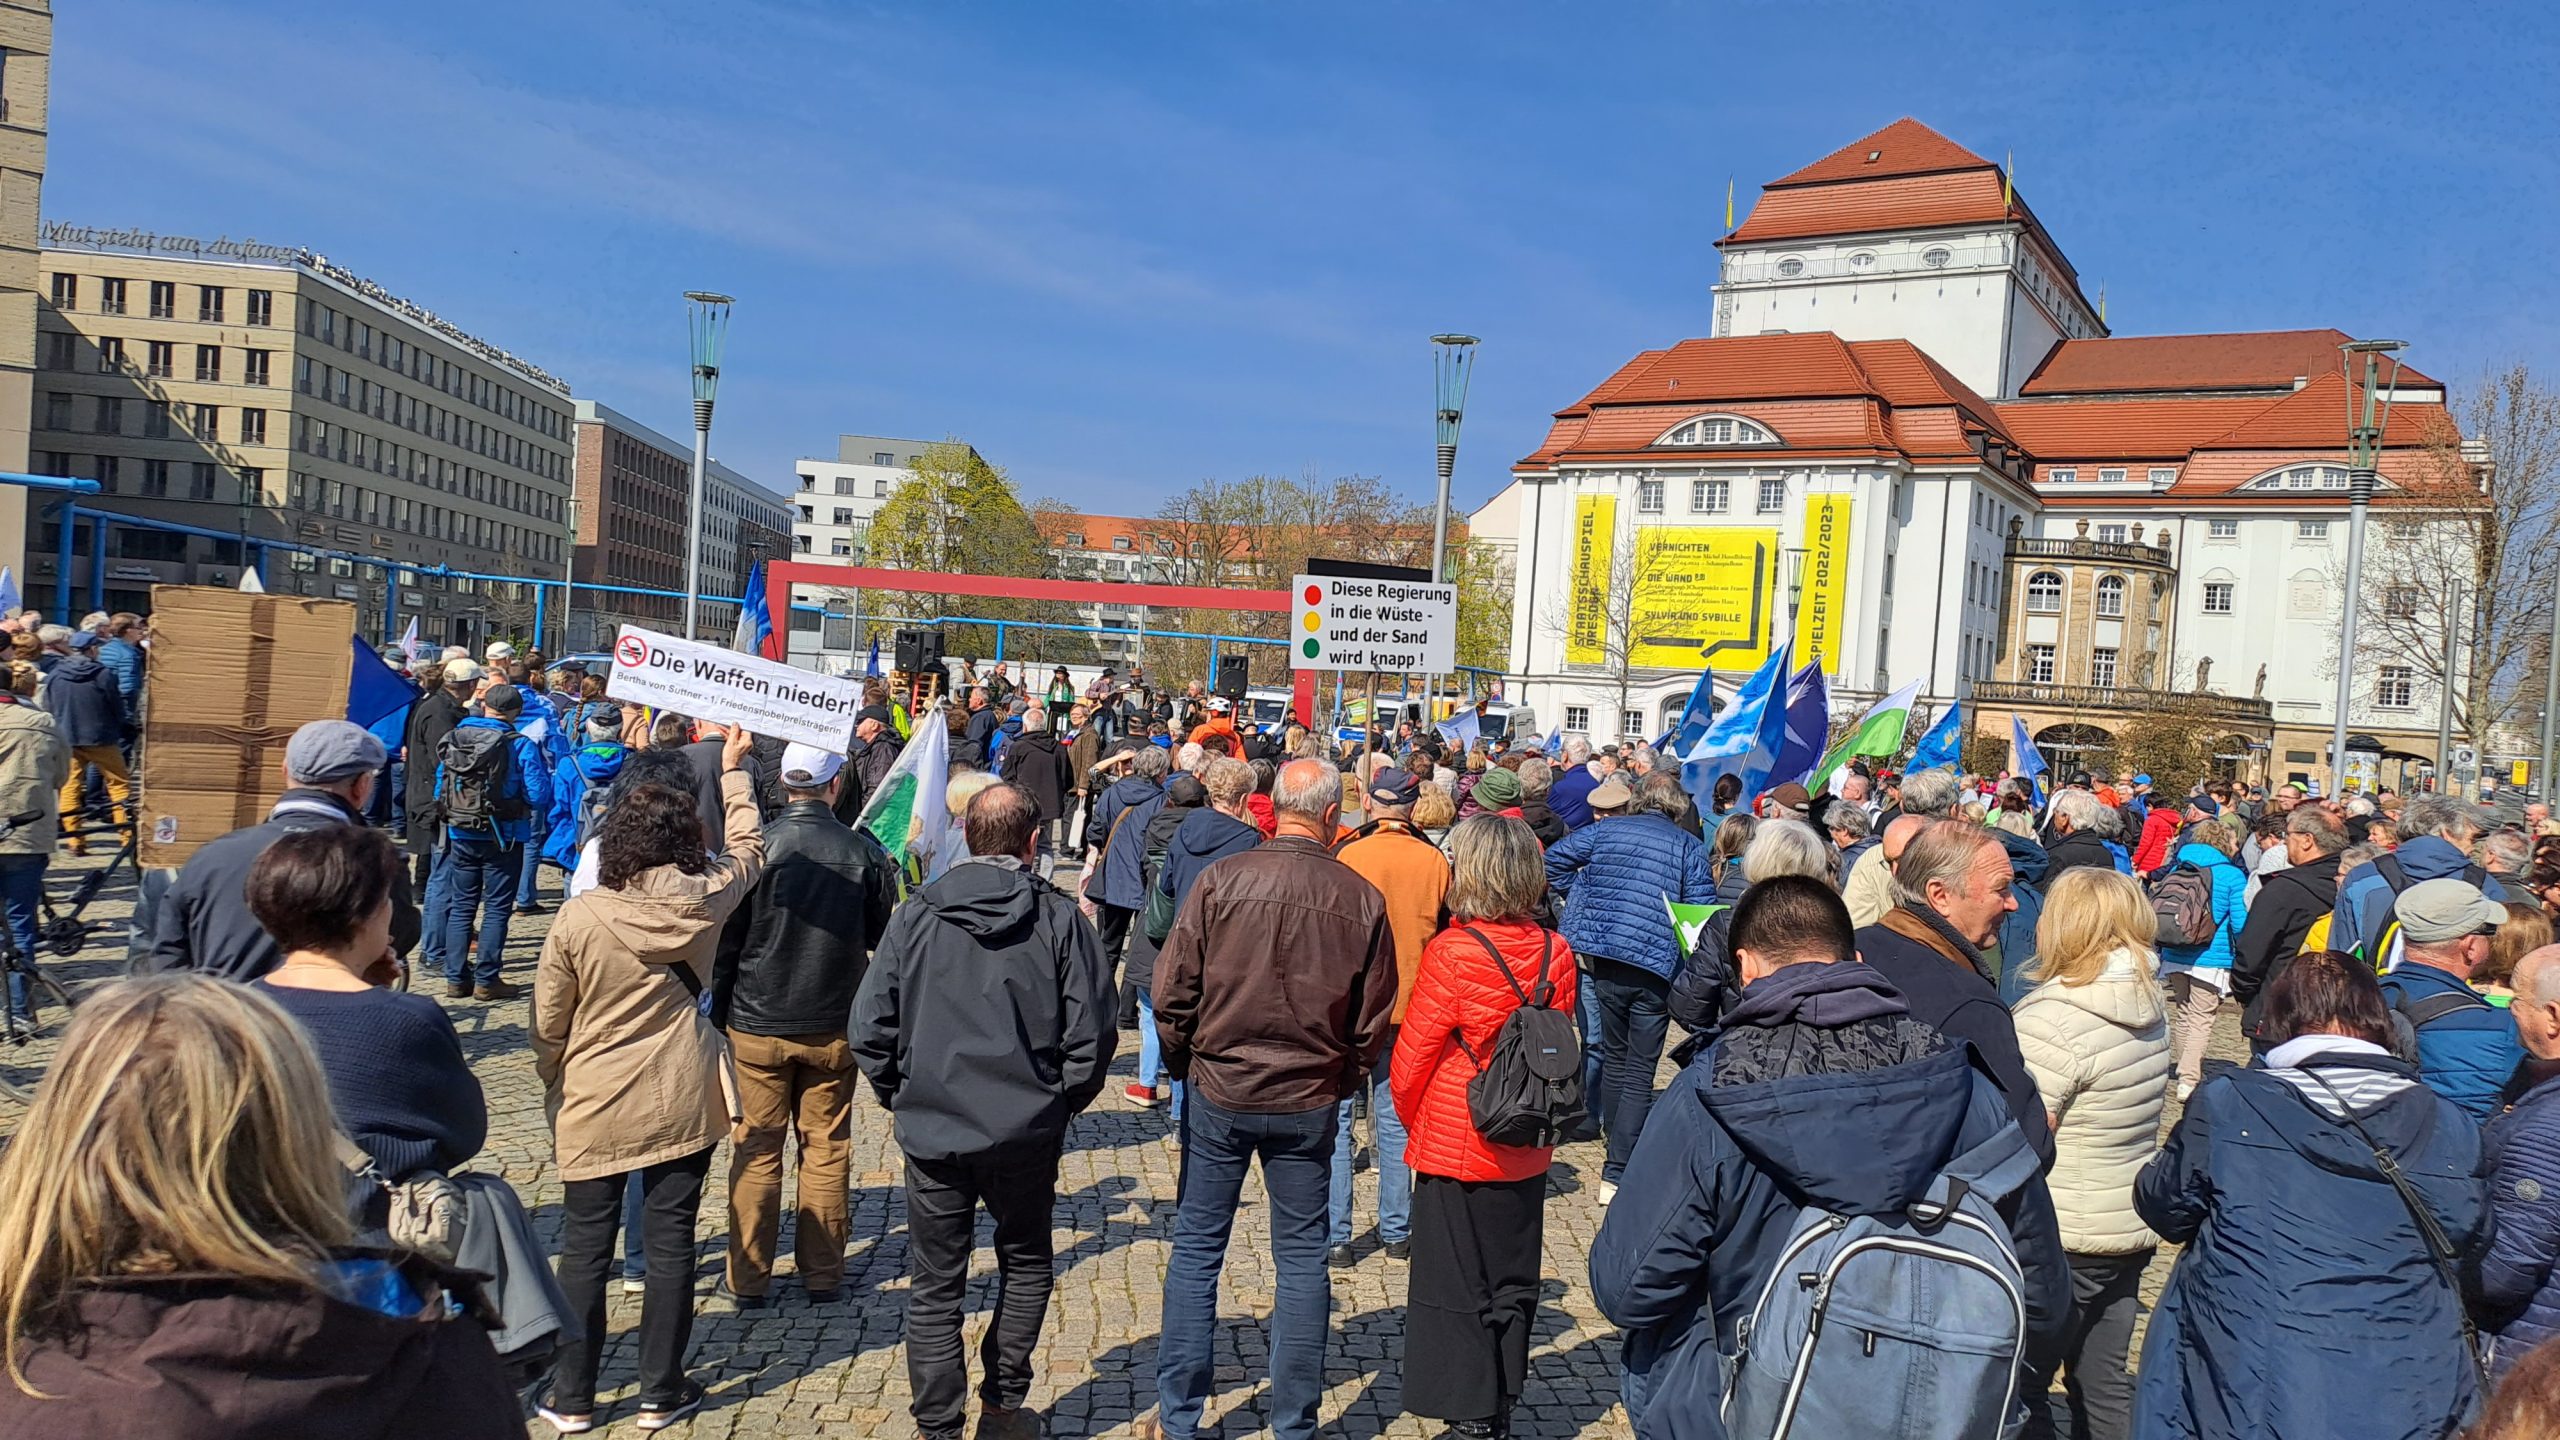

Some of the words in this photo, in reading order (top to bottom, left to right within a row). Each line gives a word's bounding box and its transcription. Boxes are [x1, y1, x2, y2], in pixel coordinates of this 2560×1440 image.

[97, 226, 155, 248] steht
[1649, 542, 1710, 552] VERNICHTEN
[1816, 505, 1834, 587] 2022/2023
[1575, 511, 1594, 647] STAATSSCHAUSPIEL
[1647, 573, 1664, 582] DIE
[1666, 573, 1693, 583] WAND
[1331, 580, 1373, 598] Diese
[1377, 583, 1452, 605] Regierung
[1330, 603, 1345, 619] in
[1349, 604, 1373, 620] die
[1377, 605, 1423, 622] Wüste
[1679, 611, 1699, 621] UND
[1701, 612, 1742, 623] SYBILLE
[1330, 627, 1359, 642] und
[1363, 627, 1388, 643] der
[1391, 629, 1428, 645] Sand
[1810, 592, 1827, 662] SPIELZEIT
[1329, 649, 1363, 665] wird
[1370, 650, 1415, 669] knapp
[649, 647, 686, 673] Die
[693, 658, 770, 695] Waffen
[776, 684, 856, 717] nieder!
[616, 671, 647, 686] Bertha
[648, 680, 666, 691] von
[668, 682, 703, 700] Suttner
[719, 697, 842, 736] Friedensnobelpreisträgerin
